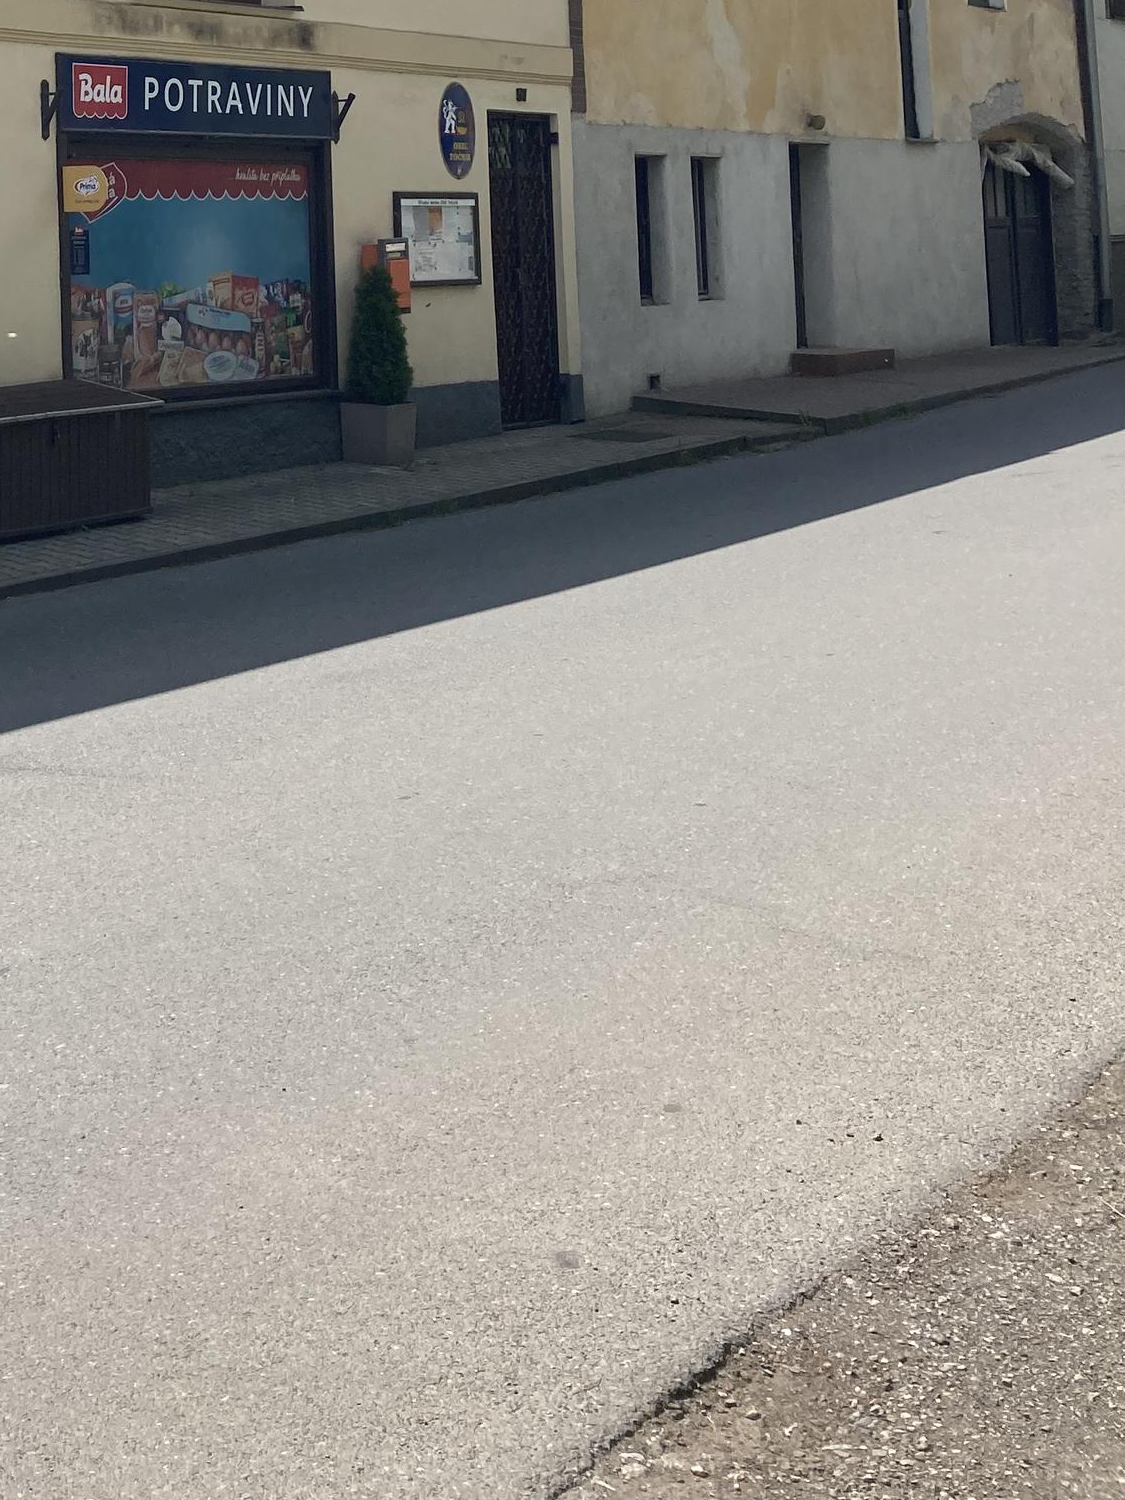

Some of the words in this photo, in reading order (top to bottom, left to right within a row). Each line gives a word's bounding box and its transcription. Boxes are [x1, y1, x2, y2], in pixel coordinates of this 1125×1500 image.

[78, 73, 123, 103] Bala
[144, 76, 313, 117] POTRAVINY
[79, 182, 96, 190] Prima
